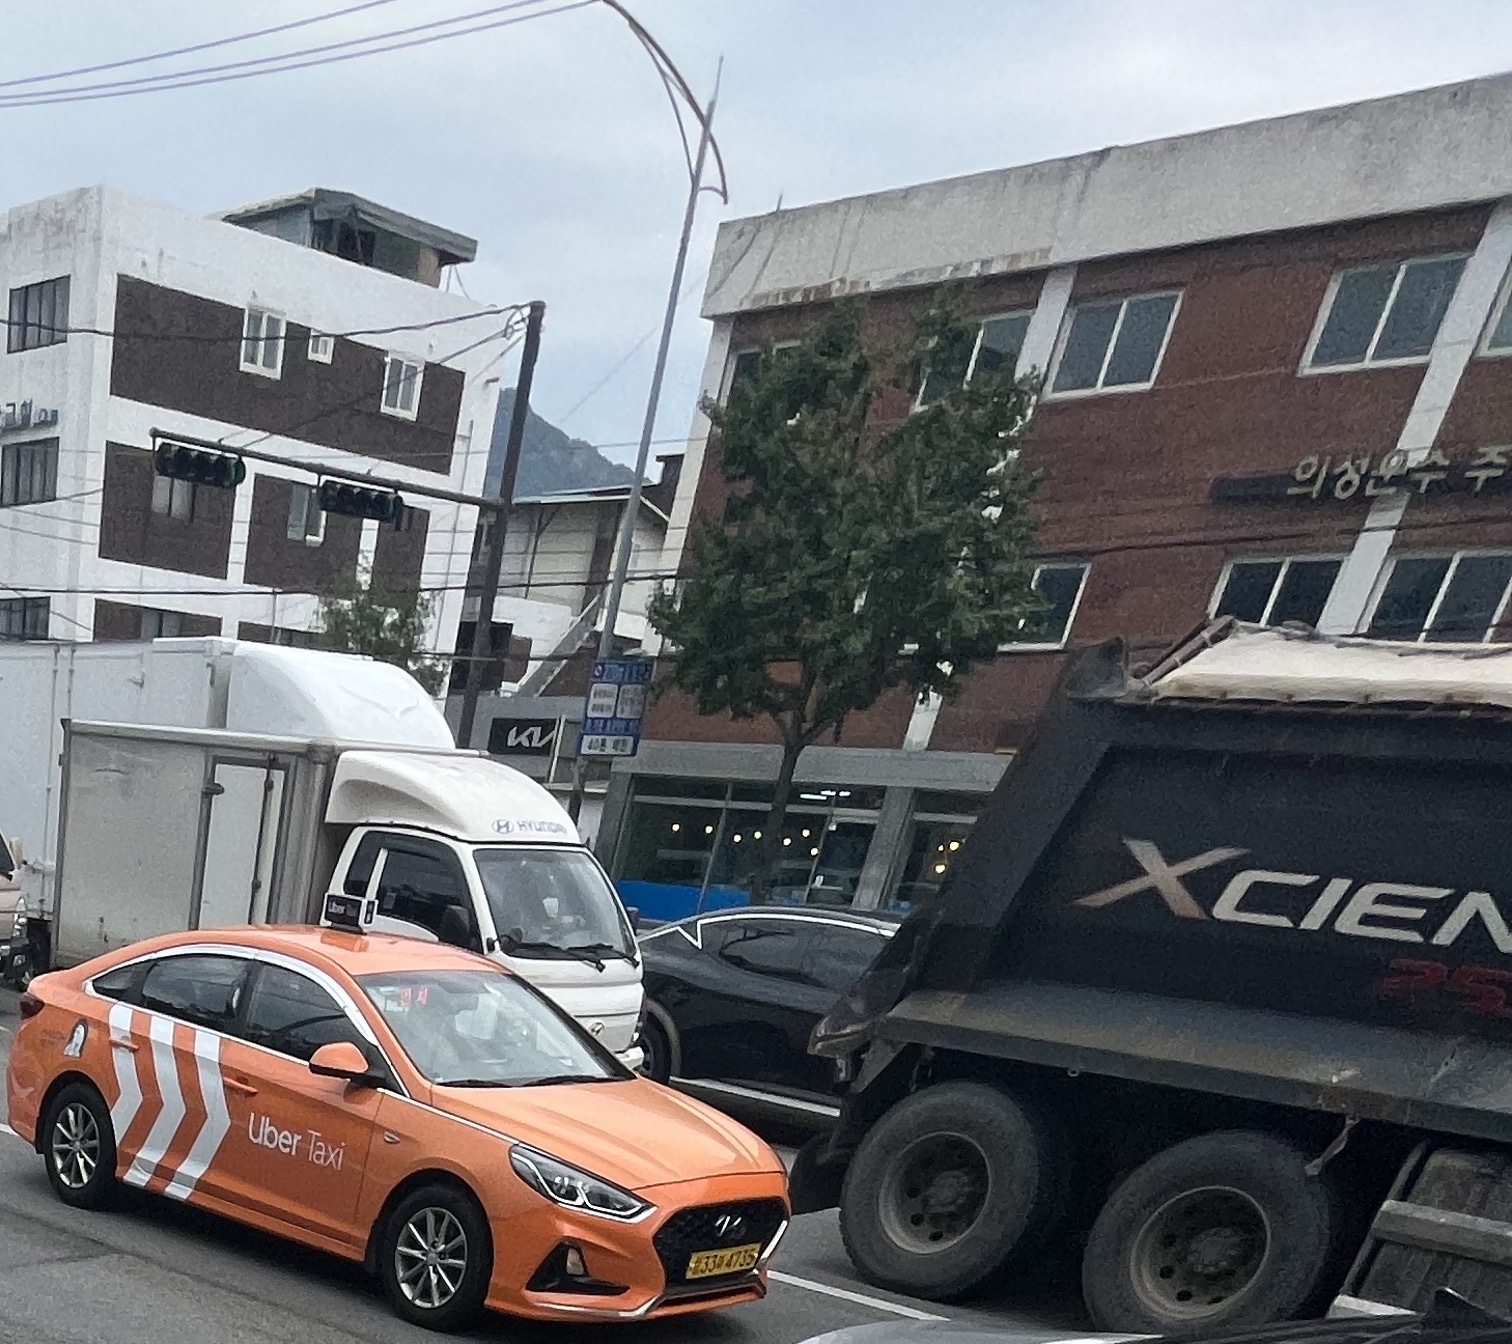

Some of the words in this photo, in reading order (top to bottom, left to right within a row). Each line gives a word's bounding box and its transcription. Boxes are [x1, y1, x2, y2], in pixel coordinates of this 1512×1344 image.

[1286, 448, 1451, 501] 의성운수
[249, 1112, 302, 1156] Uber
[307, 1128, 347, 1171] Taxi
